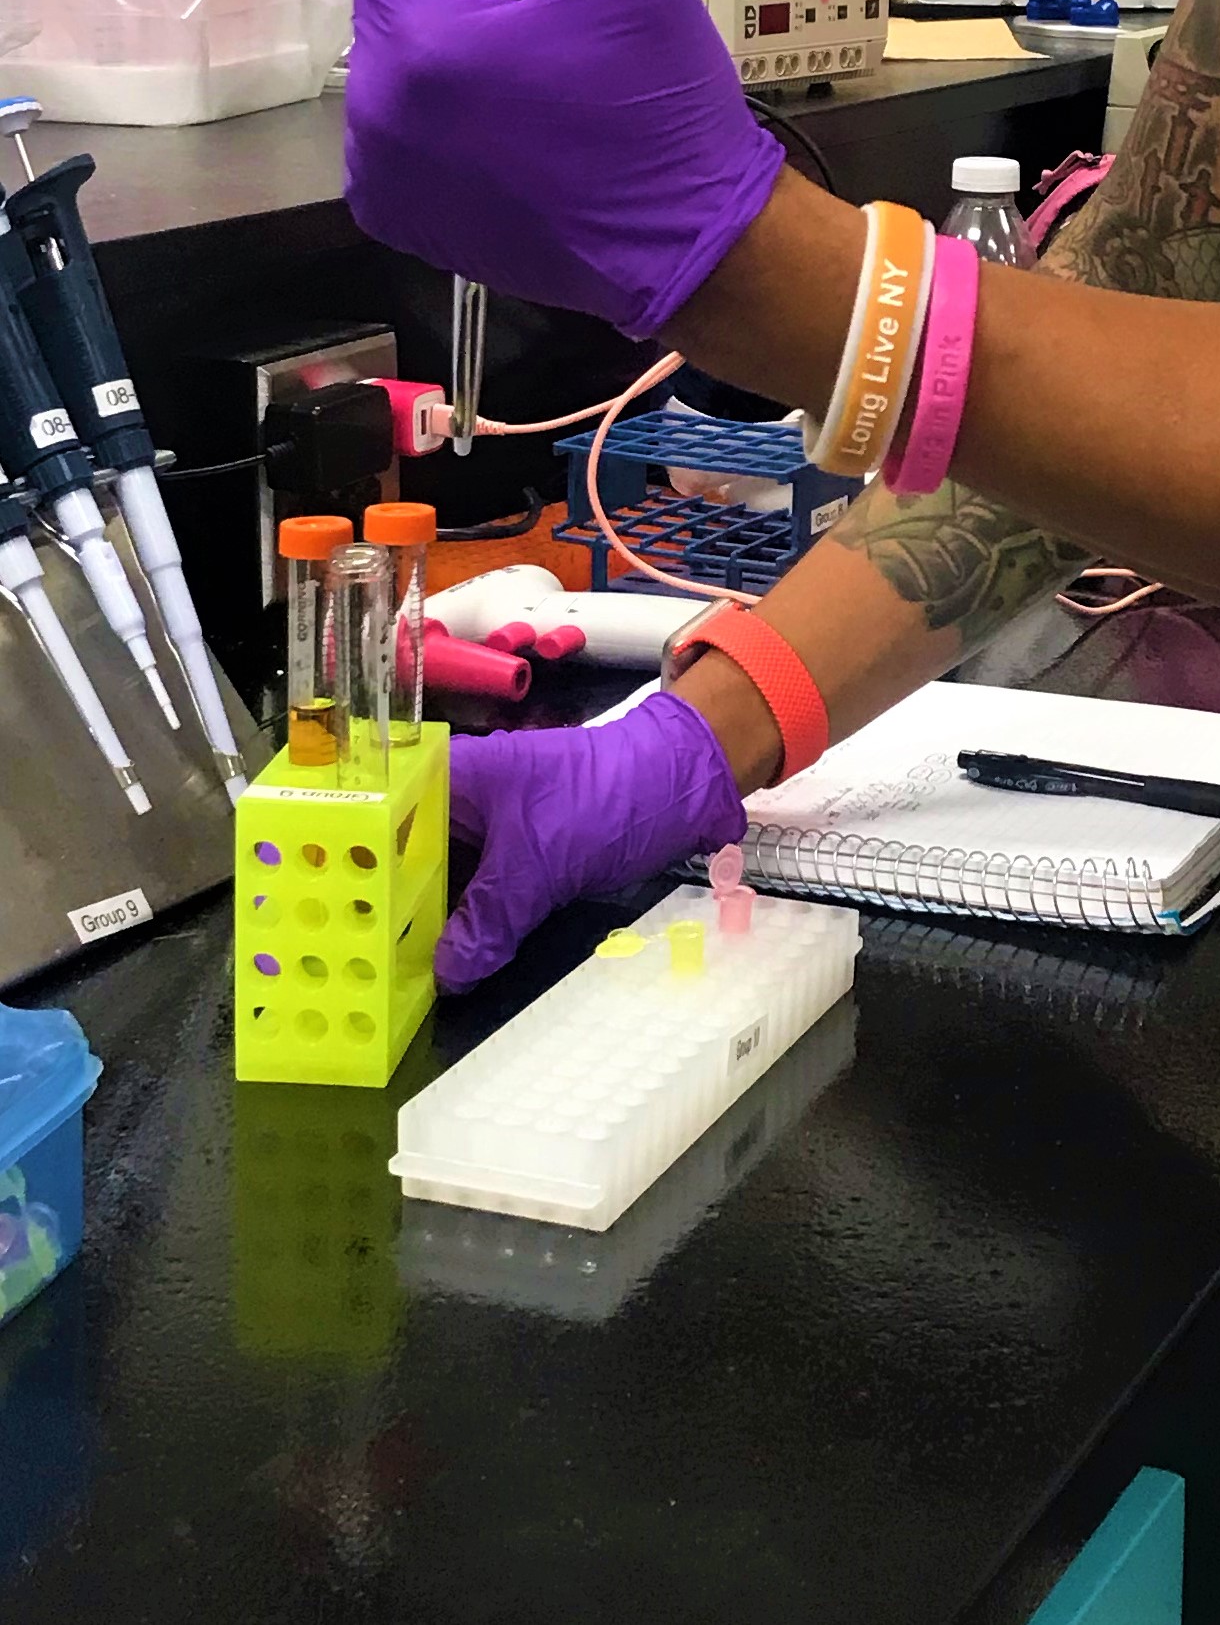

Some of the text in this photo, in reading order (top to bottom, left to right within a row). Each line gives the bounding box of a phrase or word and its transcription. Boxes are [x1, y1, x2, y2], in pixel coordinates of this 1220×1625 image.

[841, 258, 909, 455] Long Live NY
[932, 334, 962, 398] Pink
[81, 899, 139, 933] Group 9
